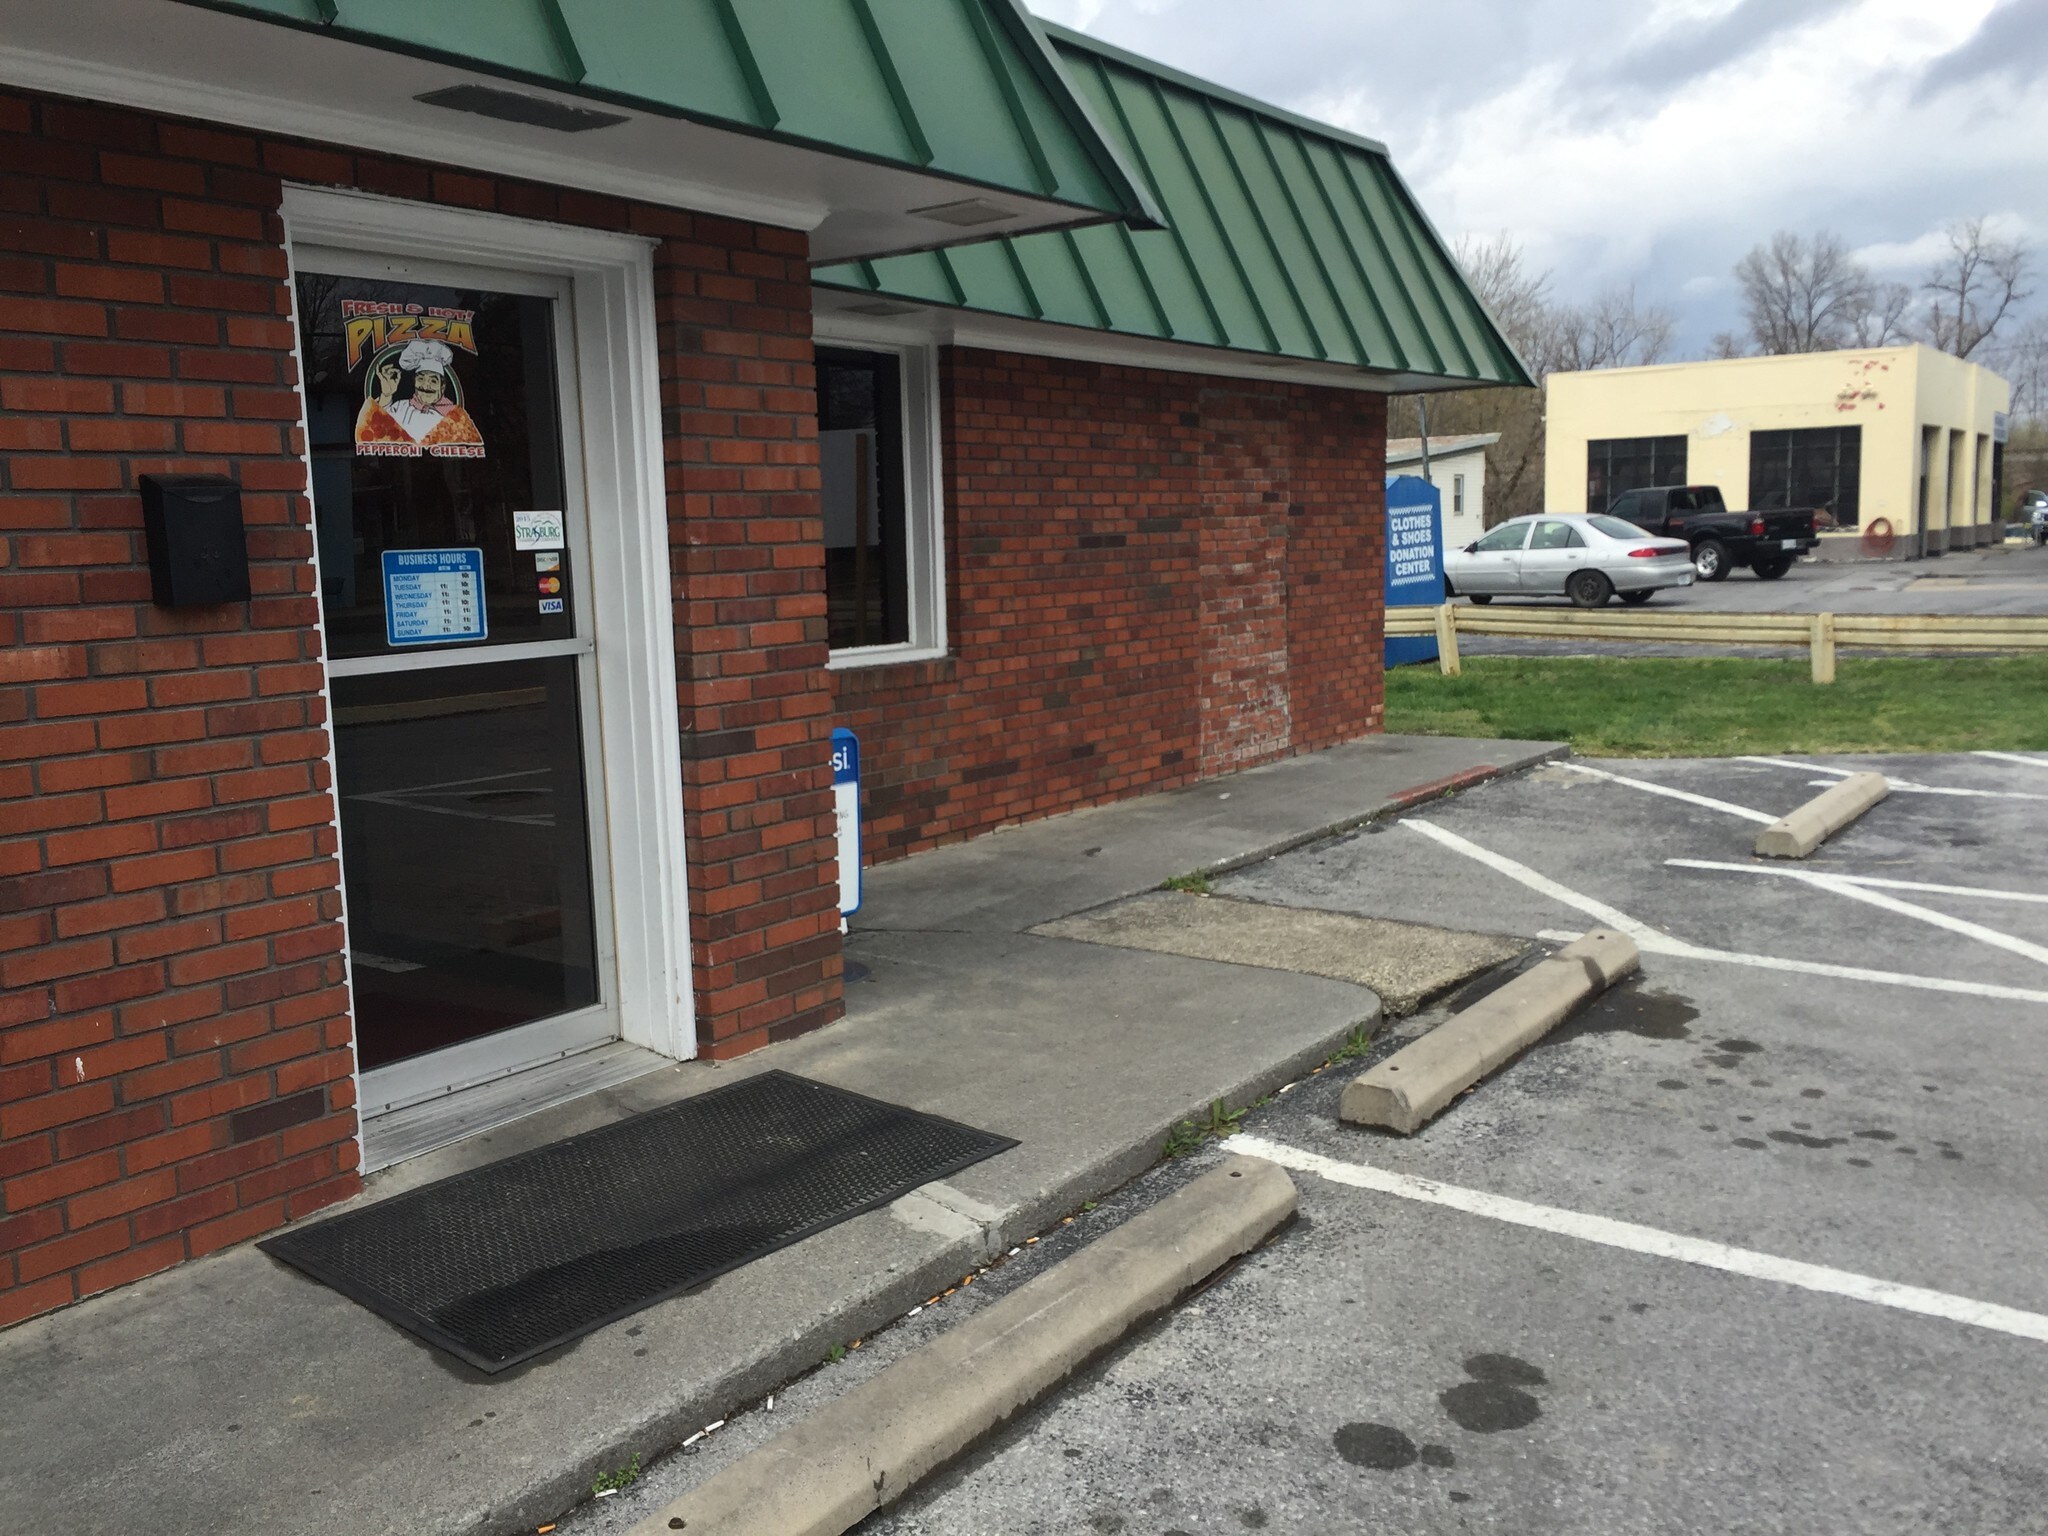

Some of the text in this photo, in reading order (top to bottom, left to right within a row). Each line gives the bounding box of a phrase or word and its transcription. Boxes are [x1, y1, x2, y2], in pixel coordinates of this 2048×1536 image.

[341, 300, 475, 321] FRESH & HOT!
[344, 315, 479, 374] PIZZA
[356, 444, 485, 458] PEPPERONI CHEESE
[1391, 515, 1431, 531] CLOTHES
[515, 525, 560, 540] STRASBURG
[1392, 529, 1431, 546] & SHOES
[398, 553, 467, 565] BUSINESS HOURS
[1390, 545, 1434, 562] DONATION
[1395, 560, 1430, 575] CENTER
[542, 601, 562, 611] VISA
[397, 620, 428, 628] SATURDAY
[828, 746, 848, 772] si
